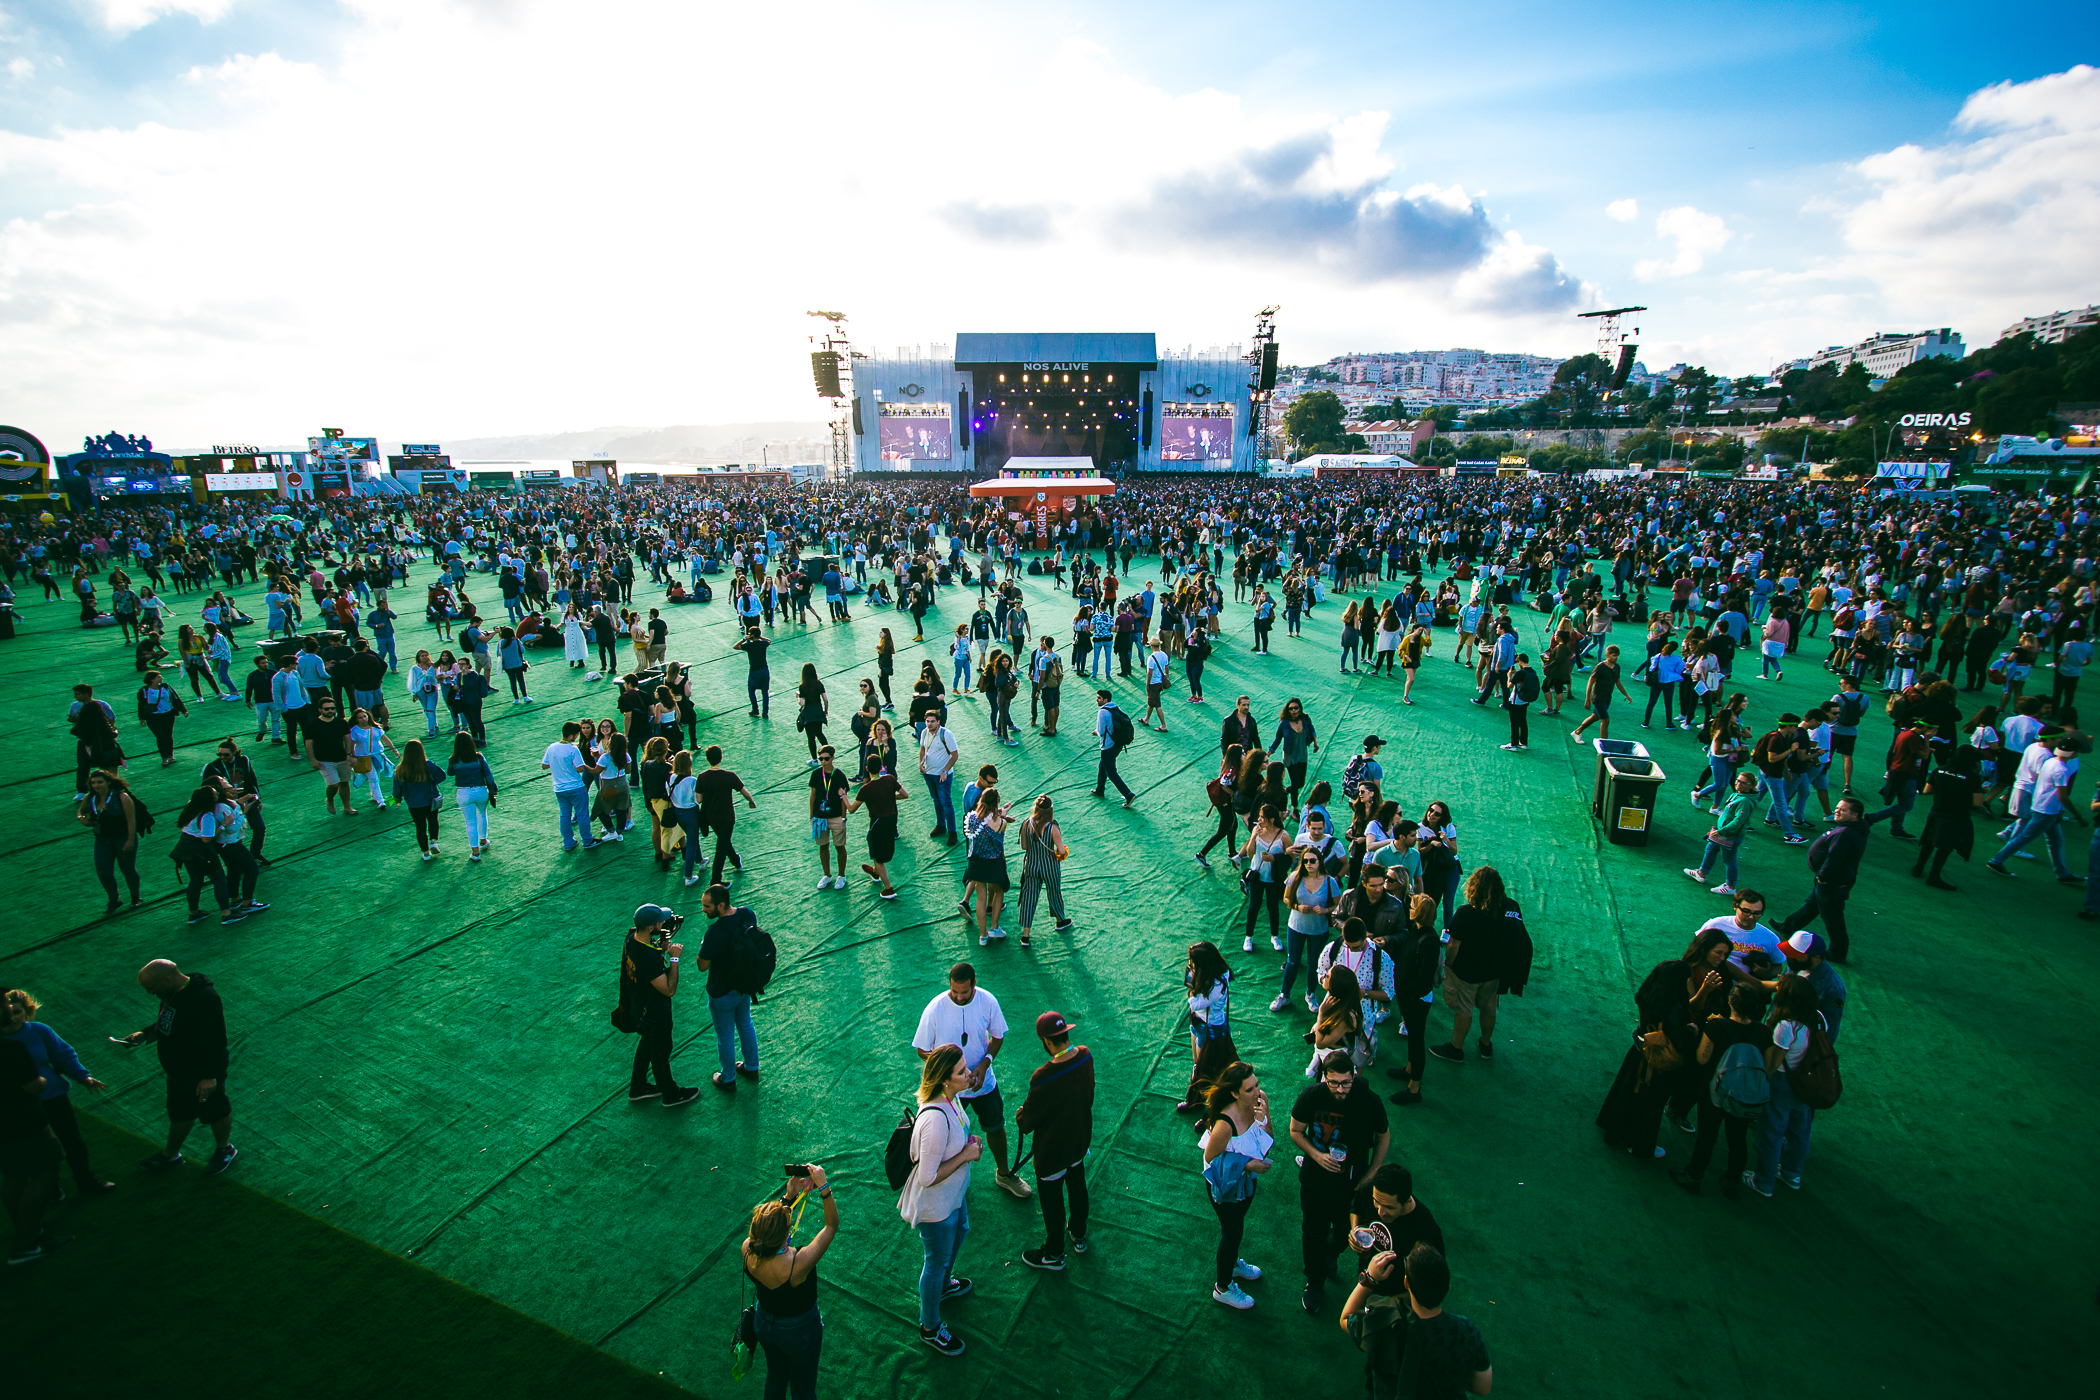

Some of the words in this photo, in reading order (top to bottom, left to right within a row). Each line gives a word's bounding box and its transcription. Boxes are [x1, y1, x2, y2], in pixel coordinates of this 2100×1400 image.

[1023, 362, 1049, 371] NOS
[1052, 362, 1089, 371] ALIVE
[898, 383, 925, 398] NOS
[1185, 383, 1212, 398] NOS
[1900, 412, 1972, 427] OEIRAS
[110, 451, 145, 459] randstad
[404, 444, 441, 453] ASUS
[1879, 463, 1950, 477] VALLY
[1037, 506, 1047, 538] SAGRES
[1373, 1225, 1389, 1245] SUPER
